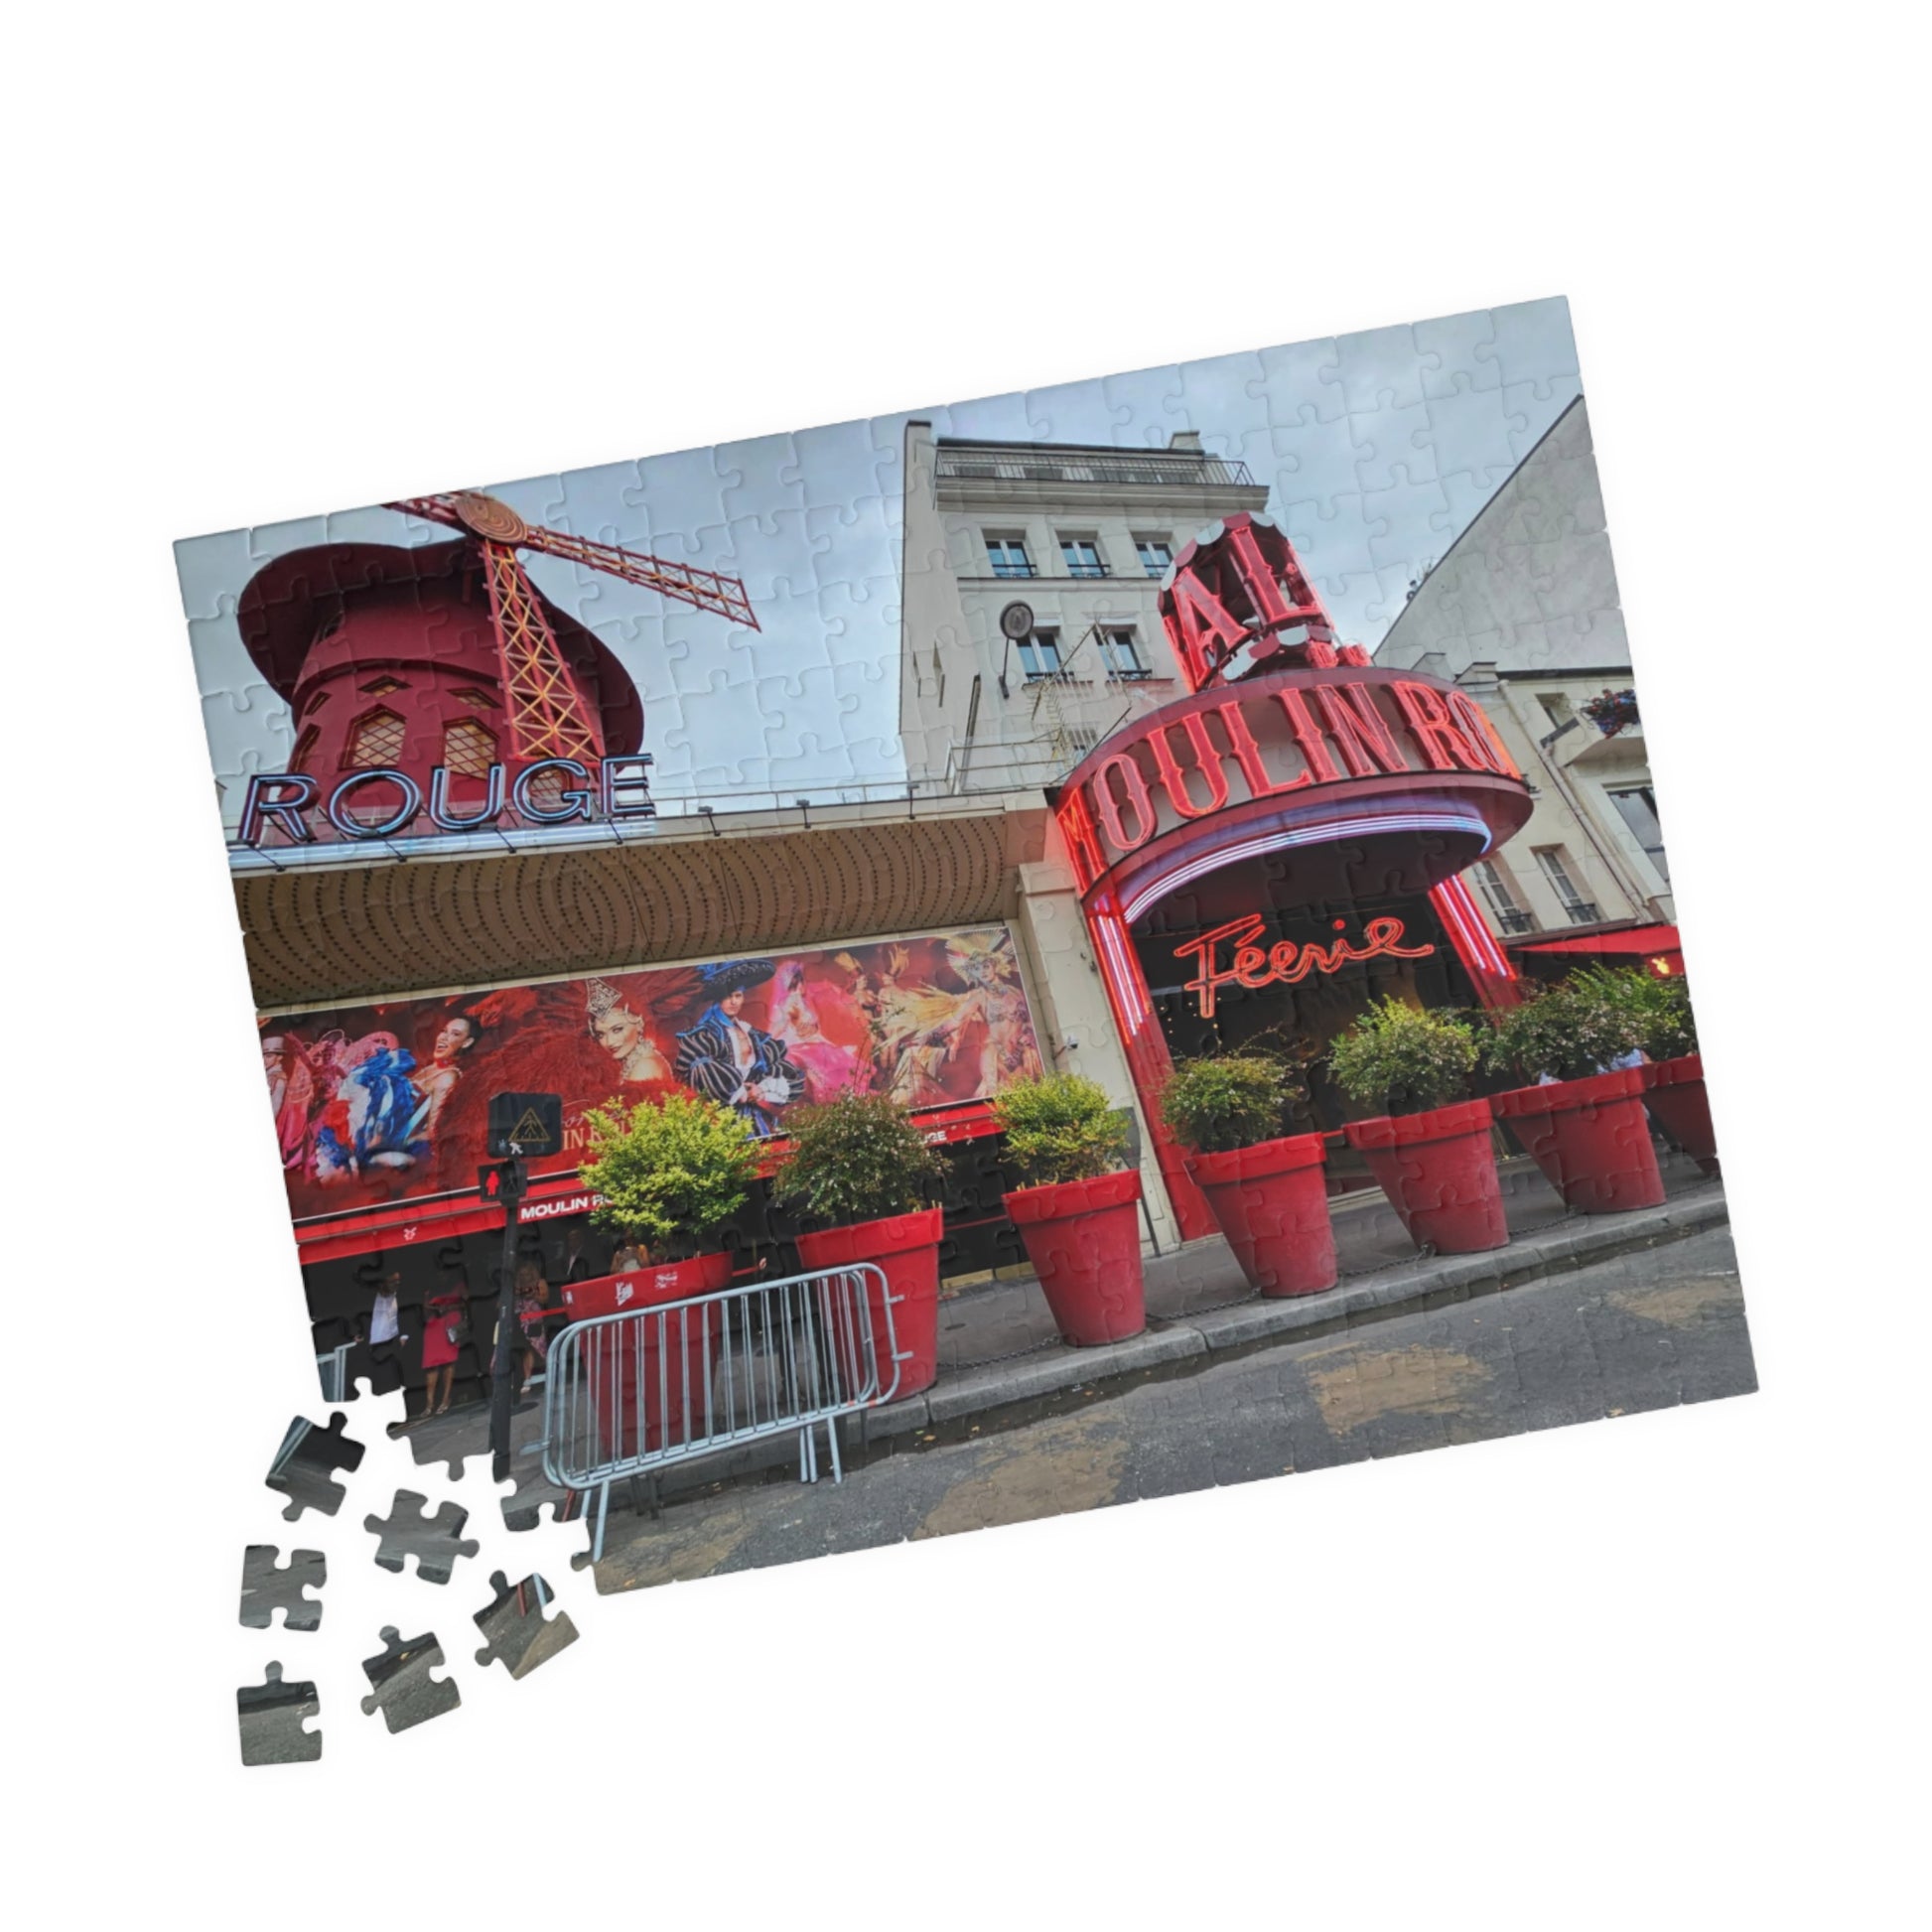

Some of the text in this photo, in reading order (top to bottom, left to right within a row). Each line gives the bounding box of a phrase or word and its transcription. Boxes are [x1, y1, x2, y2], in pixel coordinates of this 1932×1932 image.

[1164, 525, 1321, 693] AL
[237, 753, 655, 844] ROUGE
[1056, 680, 1523, 897] MOULIN RO
[520, 1196, 588, 1220] MOULIN
